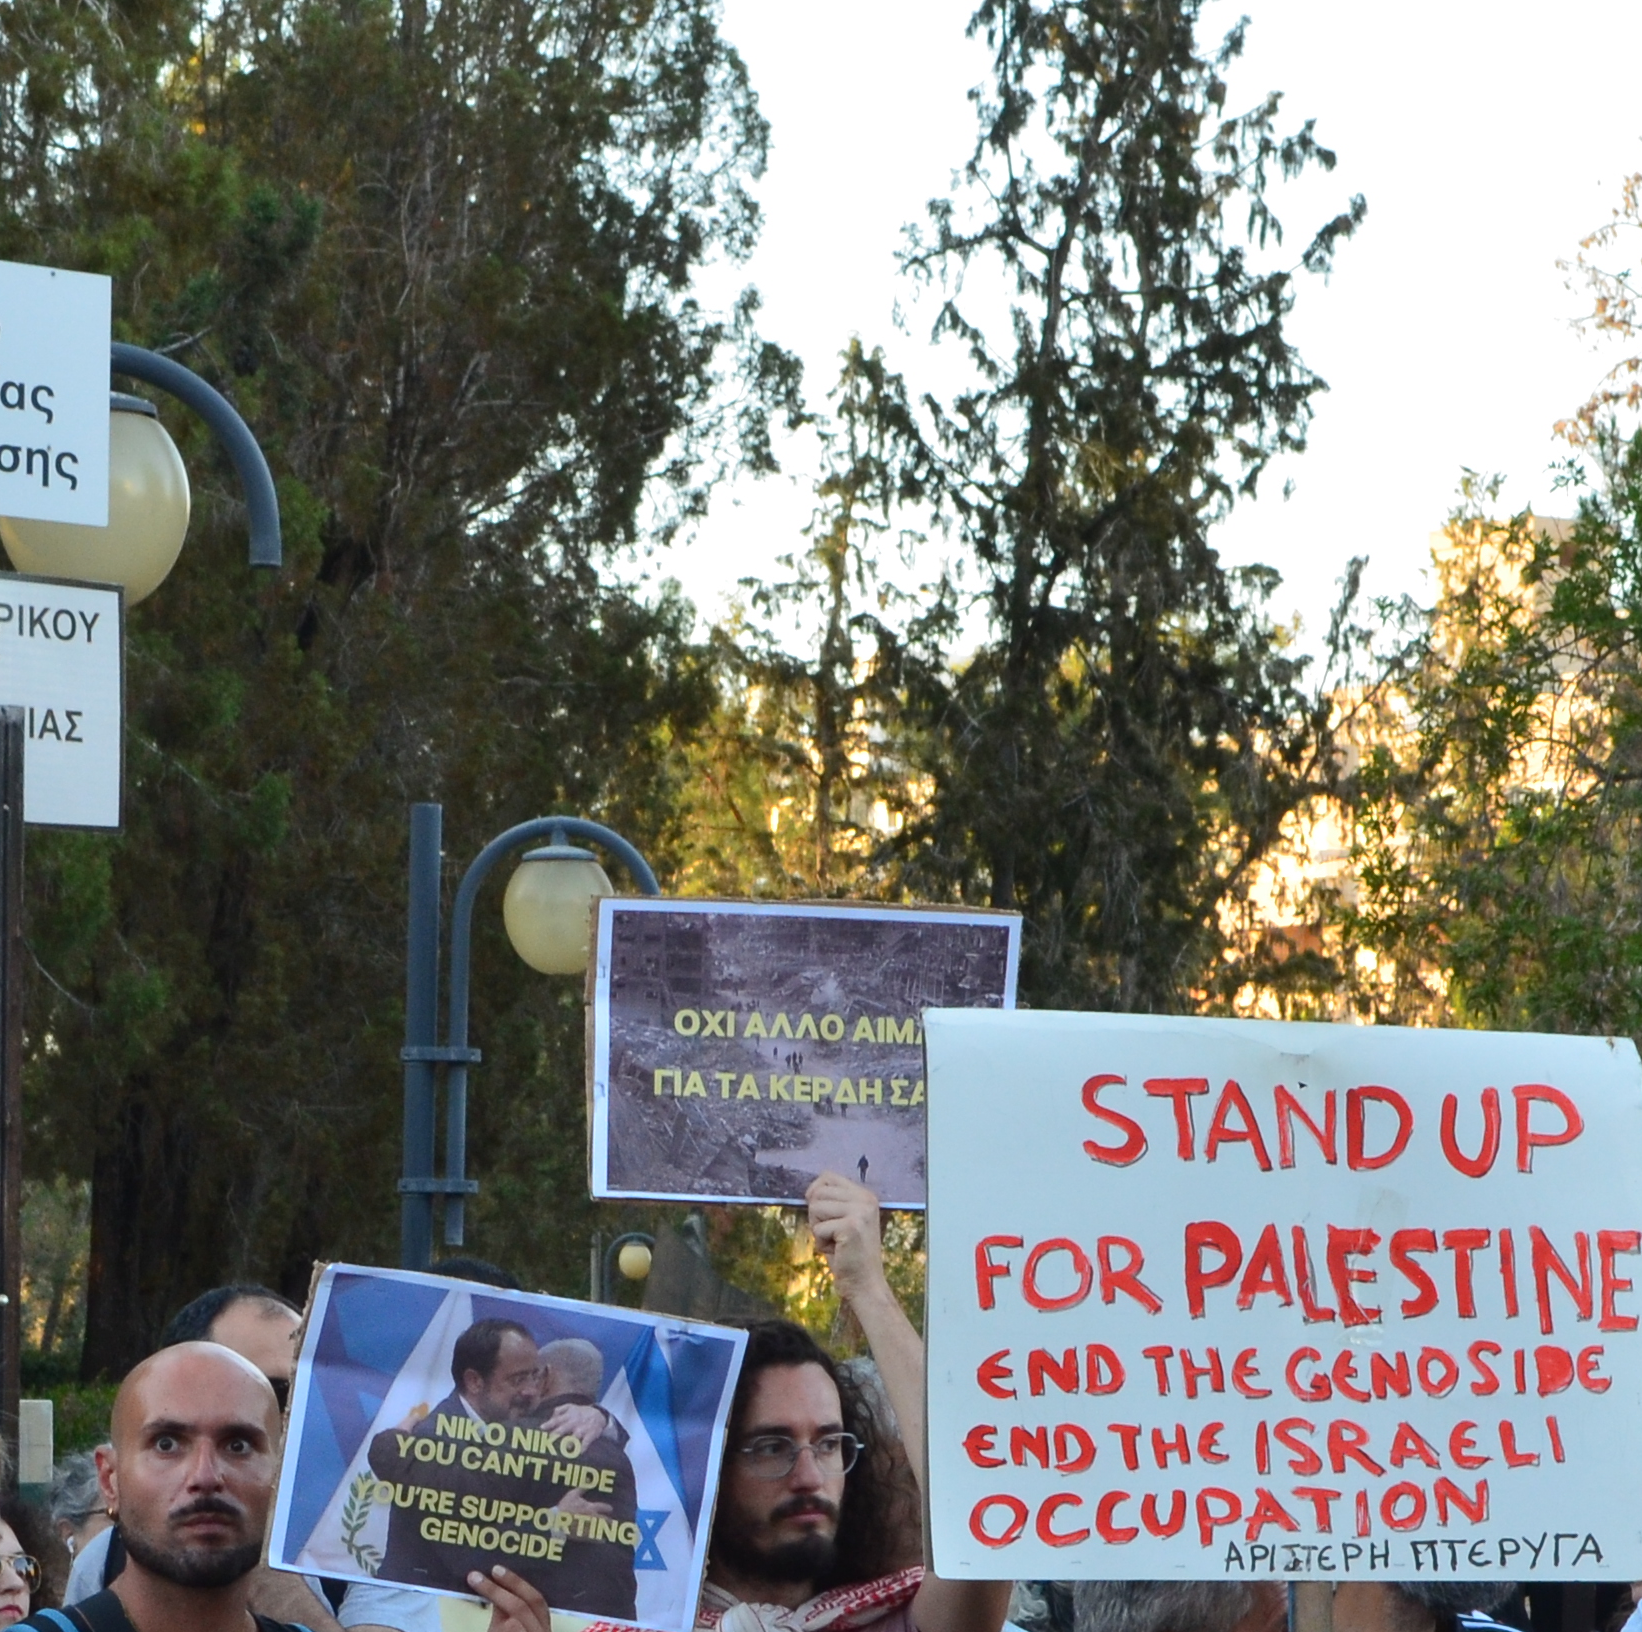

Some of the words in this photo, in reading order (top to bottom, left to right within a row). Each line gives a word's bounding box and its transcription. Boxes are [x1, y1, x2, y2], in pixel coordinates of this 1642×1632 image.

[674, 1009, 735, 1038] ΟΧΙ
[744, 1012, 845, 1042] ΑΛΛΟ
[653, 1069, 707, 1098] ΓΙΑ
[715, 1072, 761, 1101] ΤΑ
[769, 1074, 883, 1105] ΚΕΡΔΗ
[890, 1079, 925, 1106] ΣΑ
[1081, 1073, 1415, 1173] STAND
[1440, 1084, 1585, 1178] UP
[974, 1234, 1164, 1316] FOR
[1184, 1220, 1642, 1335] PALESTINE
[977, 1343, 1125, 1400] END
[1142, 1345, 1273, 1401] THE
[1285, 1340, 1613, 1404] GENOSIDE
[395, 1433, 457, 1466] YOU
[460, 1447, 550, 1481] CAN'T
[553, 1462, 617, 1494] HIDE
[434, 1412, 506, 1446] NIKO
[511, 1427, 583, 1460] NIKO
[962, 1421, 1097, 1476] END
[1108, 1421, 1231, 1471] THE
[1255, 1415, 1566, 1478] ISRAELI
[357, 1477, 456, 1517] YOU'RE
[458, 1495, 639, 1546] SUPPORTING
[419, 1516, 566, 1562] GENOCIDE
[969, 1478, 1490, 1548] OCCUPATION
[1410, 1531, 1604, 1573] ΠΤΕΡΥΓΑ
